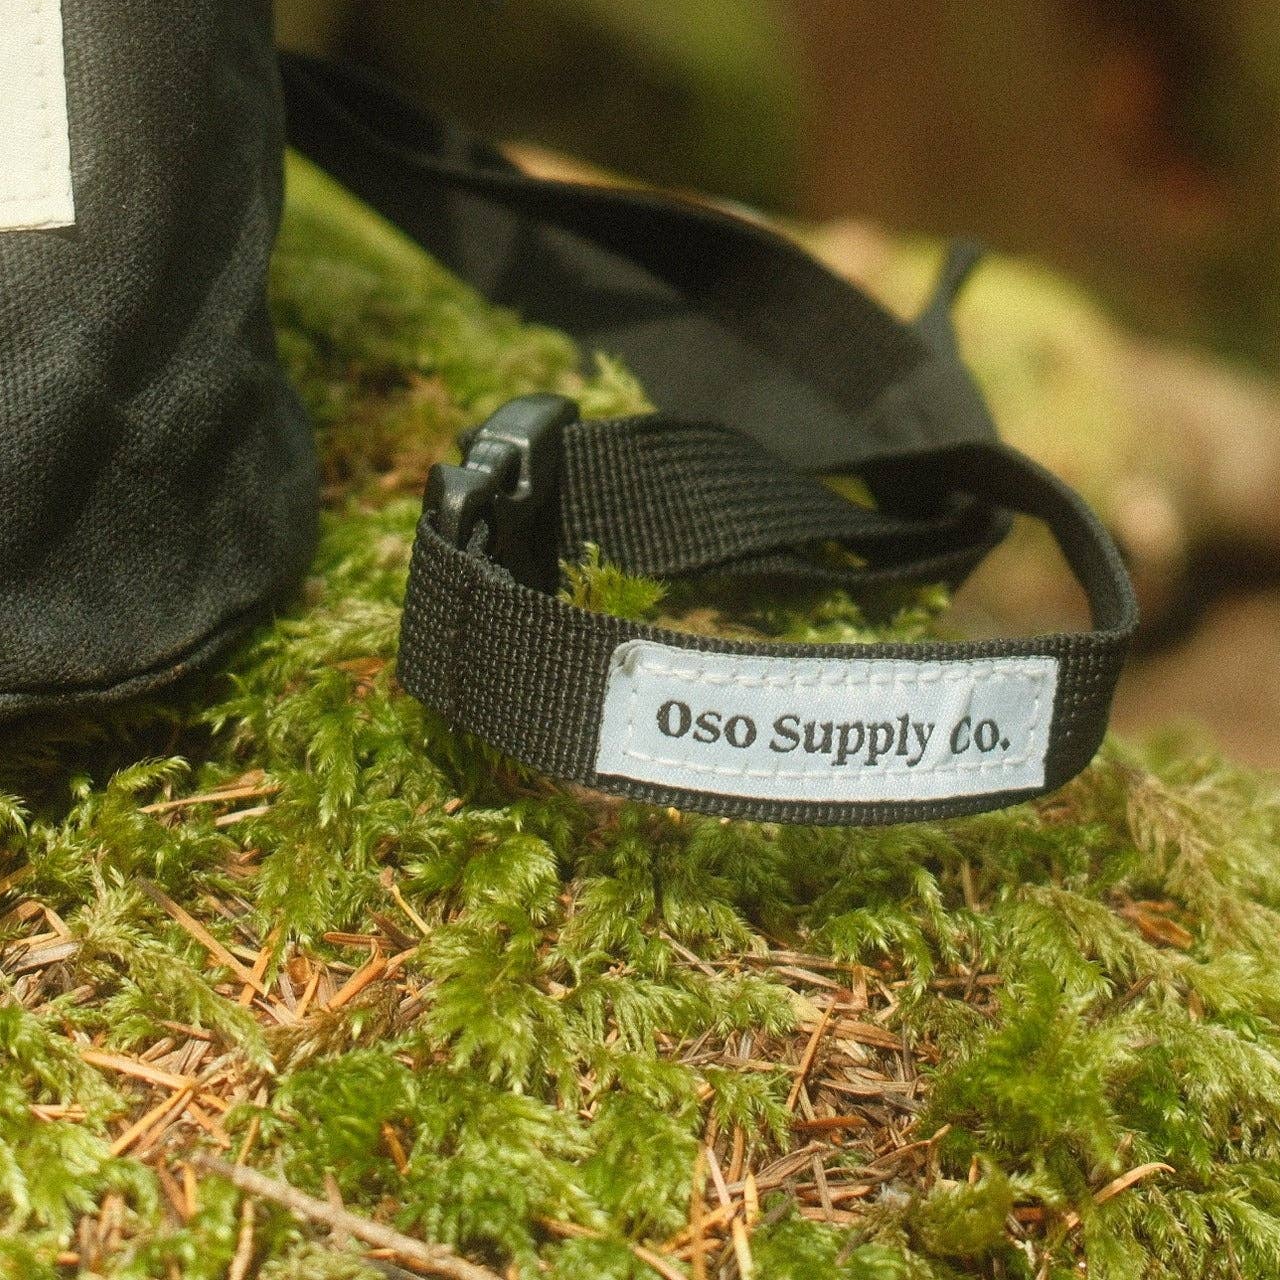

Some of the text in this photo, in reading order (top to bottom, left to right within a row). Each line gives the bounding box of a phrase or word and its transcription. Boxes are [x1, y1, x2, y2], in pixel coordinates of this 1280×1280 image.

[656, 699, 1011, 767] Oso Supply Co.
